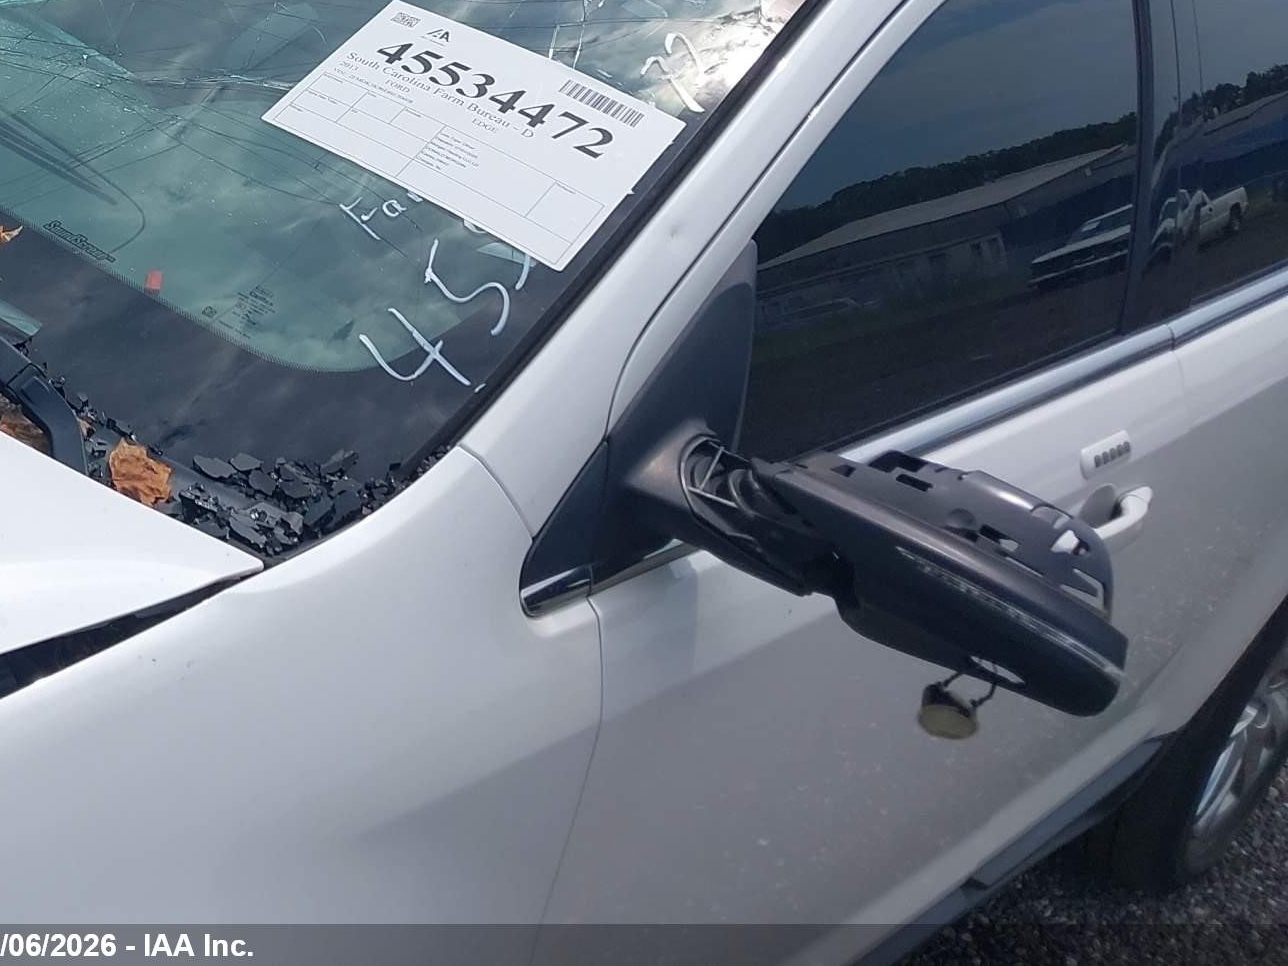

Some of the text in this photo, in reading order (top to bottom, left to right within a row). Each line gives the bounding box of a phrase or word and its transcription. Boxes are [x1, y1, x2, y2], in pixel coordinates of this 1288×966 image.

[339, 60, 359, 71] 2013
[384, 79, 411, 93] FORD
[472, 118, 498, 133] EDGE
[346, 51, 380, 70] South
[382, 66, 431, 91] Carolina
[433, 87, 465, 106] Farm
[467, 102, 511, 128] Bureau
[521, 128, 534, 138] D
[376, 43, 613, 159] 45534472
